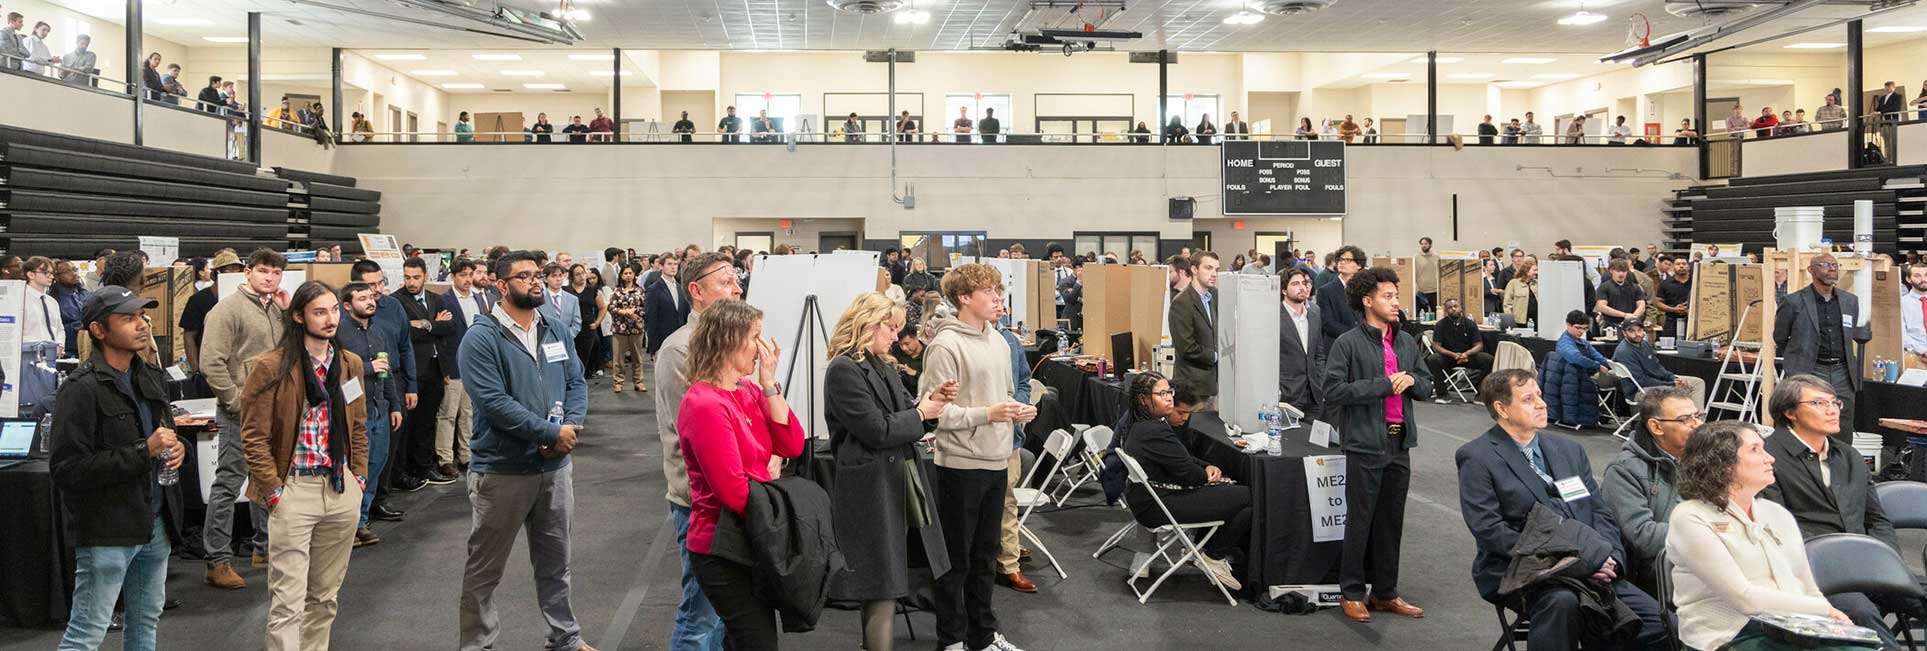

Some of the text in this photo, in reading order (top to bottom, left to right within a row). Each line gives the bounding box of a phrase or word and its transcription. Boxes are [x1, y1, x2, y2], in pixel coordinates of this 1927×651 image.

[1227, 159, 1254, 167] HOME
[1314, 159, 1341, 167] GUEST
[1317, 475, 1346, 488] ME2
[1328, 496, 1343, 507] to
[1321, 514, 1347, 527] ME2
